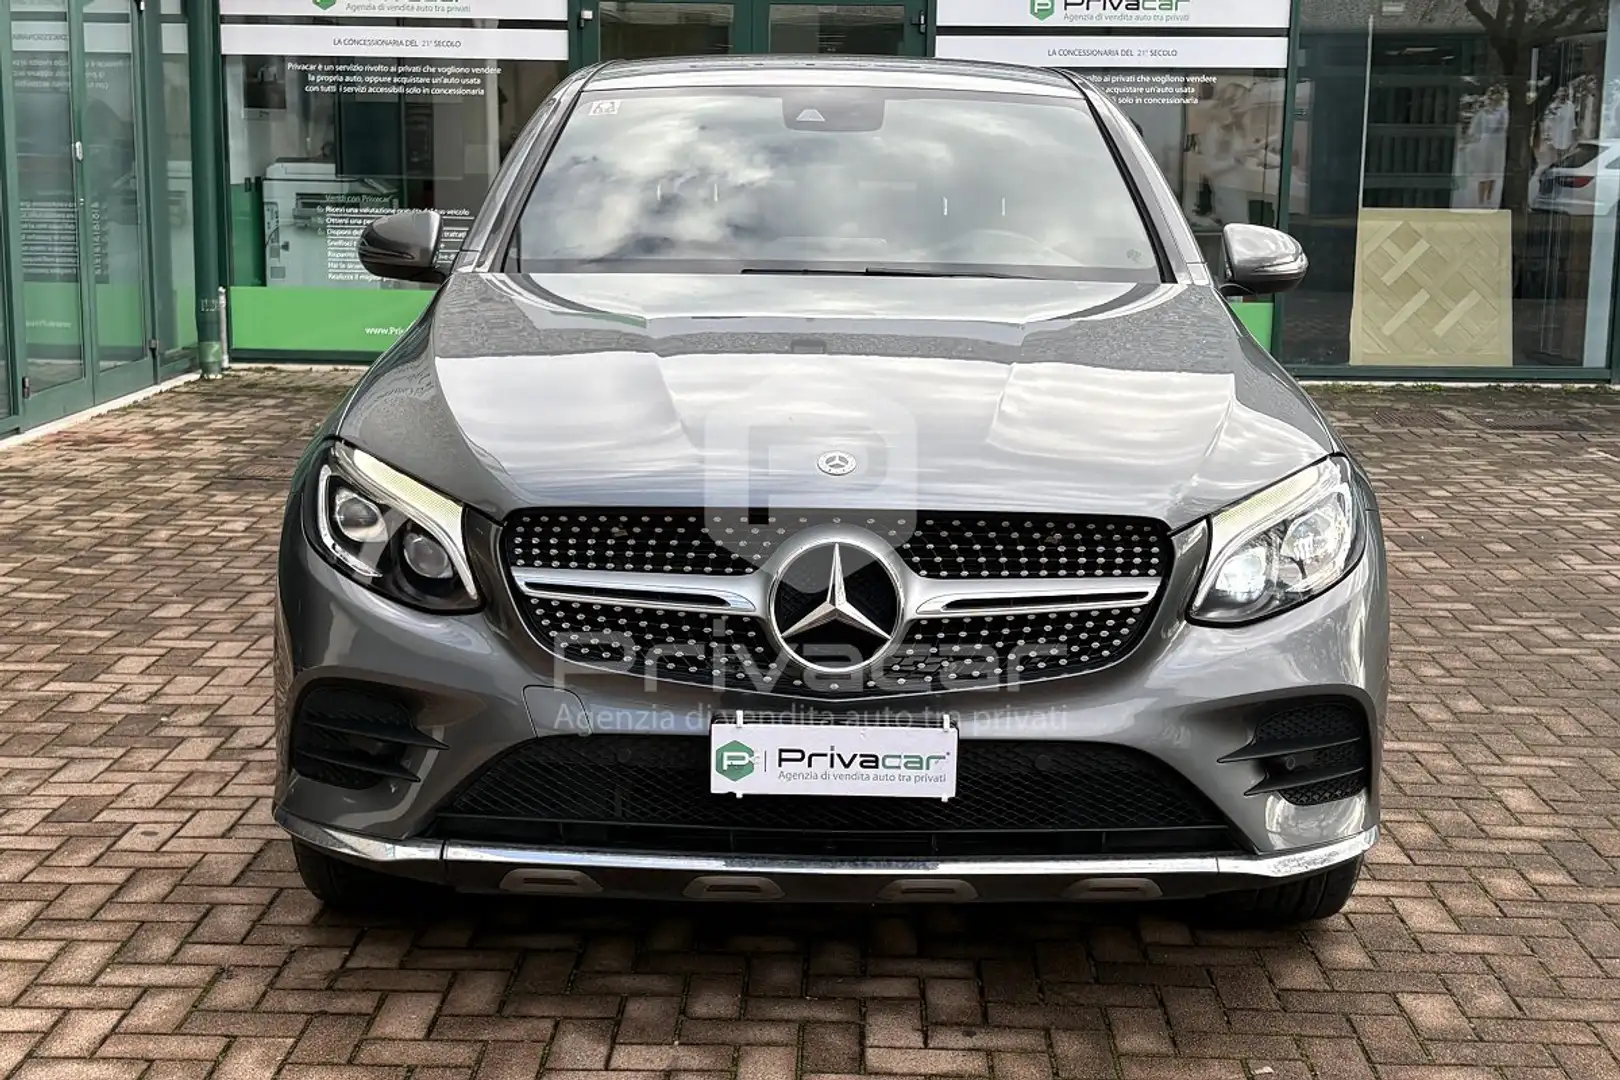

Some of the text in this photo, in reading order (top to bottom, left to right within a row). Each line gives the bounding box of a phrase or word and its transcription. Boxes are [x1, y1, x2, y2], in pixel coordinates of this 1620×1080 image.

[345, 3, 376, 12] Agenzia
[377, 3, 385, 11] di
[385, 4, 415, 12] vendita
[446, 5, 471, 14] privati
[1063, 13, 1094, 22] Agenzia
[1094, 13, 1103, 21] di
[1104, 13, 1133, 21] vendita
[1165, 14, 1190, 22] privati
[343, 39, 403, 47] CONCESSIONARIA
[434, 40, 462, 48] SECOLO
[1058, 49, 1119, 57] CONCESSIONARIA
[1120, 49, 1134, 57] DEL
[1150, 49, 1178, 57] SECOLO
[287, 62, 317, 71] Privacar
[335, 64, 364, 72] servizio
[364, 64, 389, 73] rivolto
[398, 65, 421, 74] privati
[422, 65, 437, 73] che
[437, 66, 471, 75] vogliono
[471, 66, 502, 75] vendere
[308, 73, 316, 81] la
[316, 74, 344, 83] propria
[364, 76, 391, 84] oppure
[392, 75, 430, 85] acquistare
[1111, 75, 1136, 84] privati
[1136, 75, 1151, 83] che
[1151, 75, 1185, 85] vogliono
[1185, 75, 1218, 83] vendere
[320, 85, 337, 93] tutti
[342, 85, 366, 93] servizi
[367, 86, 405, 94] accessibili
[405, 86, 421, 95] solo
[430, 87, 485, 96] concessionaria
[1105, 86, 1144, 95] acquistare
[1118, 96, 1134, 104] solo
[1135, 96, 1143, 104] in
[1143, 96, 1199, 105] concessionaria
[325, 205, 346, 213] Ricevi
[777, 745, 947, 771] Privacar
[777, 770, 947, 785] Agenzia di vendita auto tra privati
